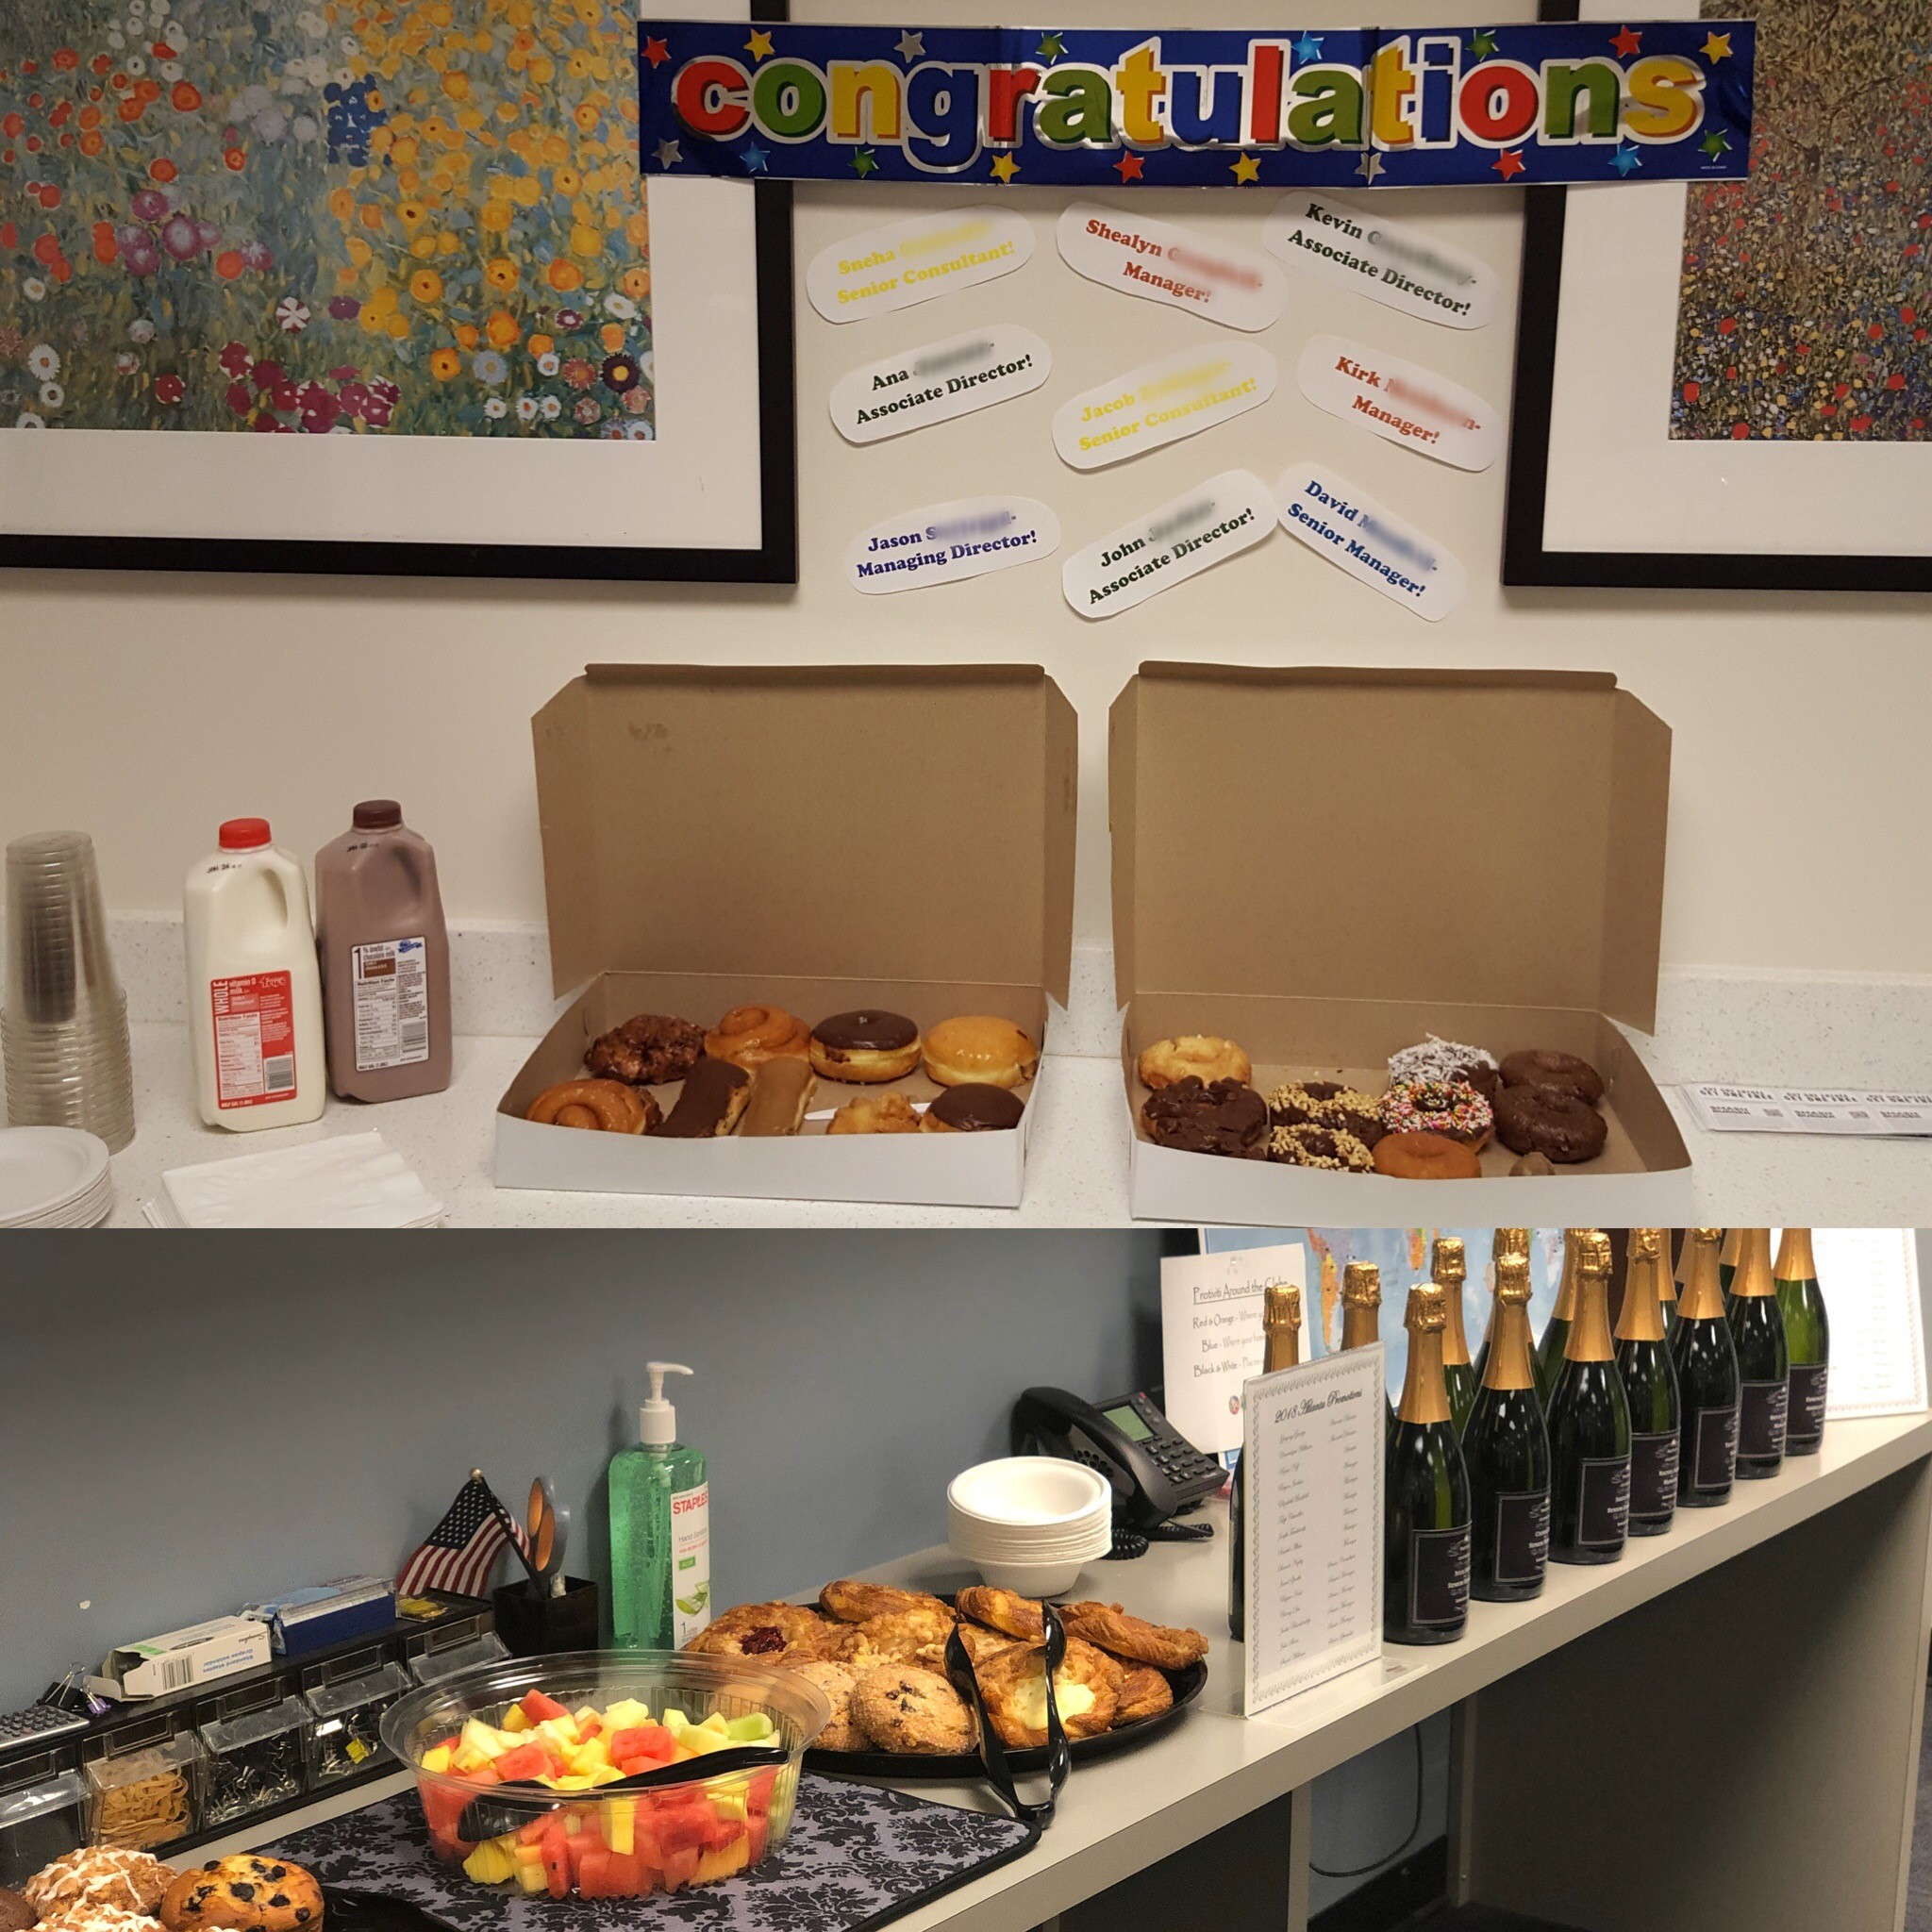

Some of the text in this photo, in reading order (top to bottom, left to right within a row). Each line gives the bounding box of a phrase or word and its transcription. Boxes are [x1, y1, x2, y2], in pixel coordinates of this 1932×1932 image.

[671, 36, 1707, 175] congratulations
[1086, 219, 1162, 258] Shealyn
[1305, 203, 1363, 240] Kevin
[837, 248, 896, 275] Sneha
[837, 241, 1016, 305] Senior Consultant!
[1288, 229, 1379, 277] Associate
[1380, 267, 1472, 316] Director!
[1123, 261, 1212, 304] Manager!
[857, 387, 943, 425] Associate
[945, 354, 1033, 394] Director!
[872, 369, 909, 391] Ana
[1335, 357, 1381, 388] Kirk
[1078, 421, 1141, 451] Senior
[1144, 377, 1257, 427] Consultant!
[1081, 391, 1136, 423] Jacob
[1352, 394, 1441, 444] Manager!
[1305, 480, 1359, 522] David
[857, 530, 1037, 577] Managing Director!
[868, 530, 922, 552] Jason
[1089, 554, 1171, 605] Associate
[1171, 508, 1255, 559] Director!
[1101, 537, 1146, 567] John
[1288, 503, 1345, 545] Senior
[1344, 539, 1426, 597] Manager!
[213, 980, 229, 1015] WHOLE
[1223, 1279, 1250, 1299] Around
[1251, 1279, 1263, 1292] the
[1192, 1316, 1208, 1329] Red
[1213, 1314, 1234, 1326] Orange
[1202, 1339, 1218, 1352] Blue
[1193, 1363, 1215, 1377] Black
[1222, 1359, 1237, 1373] White
[1274, 1405, 1298, 1424] 2018
[678, 1533, 692, 1542] Hand
[226, 1655, 254, 1667] Standard
